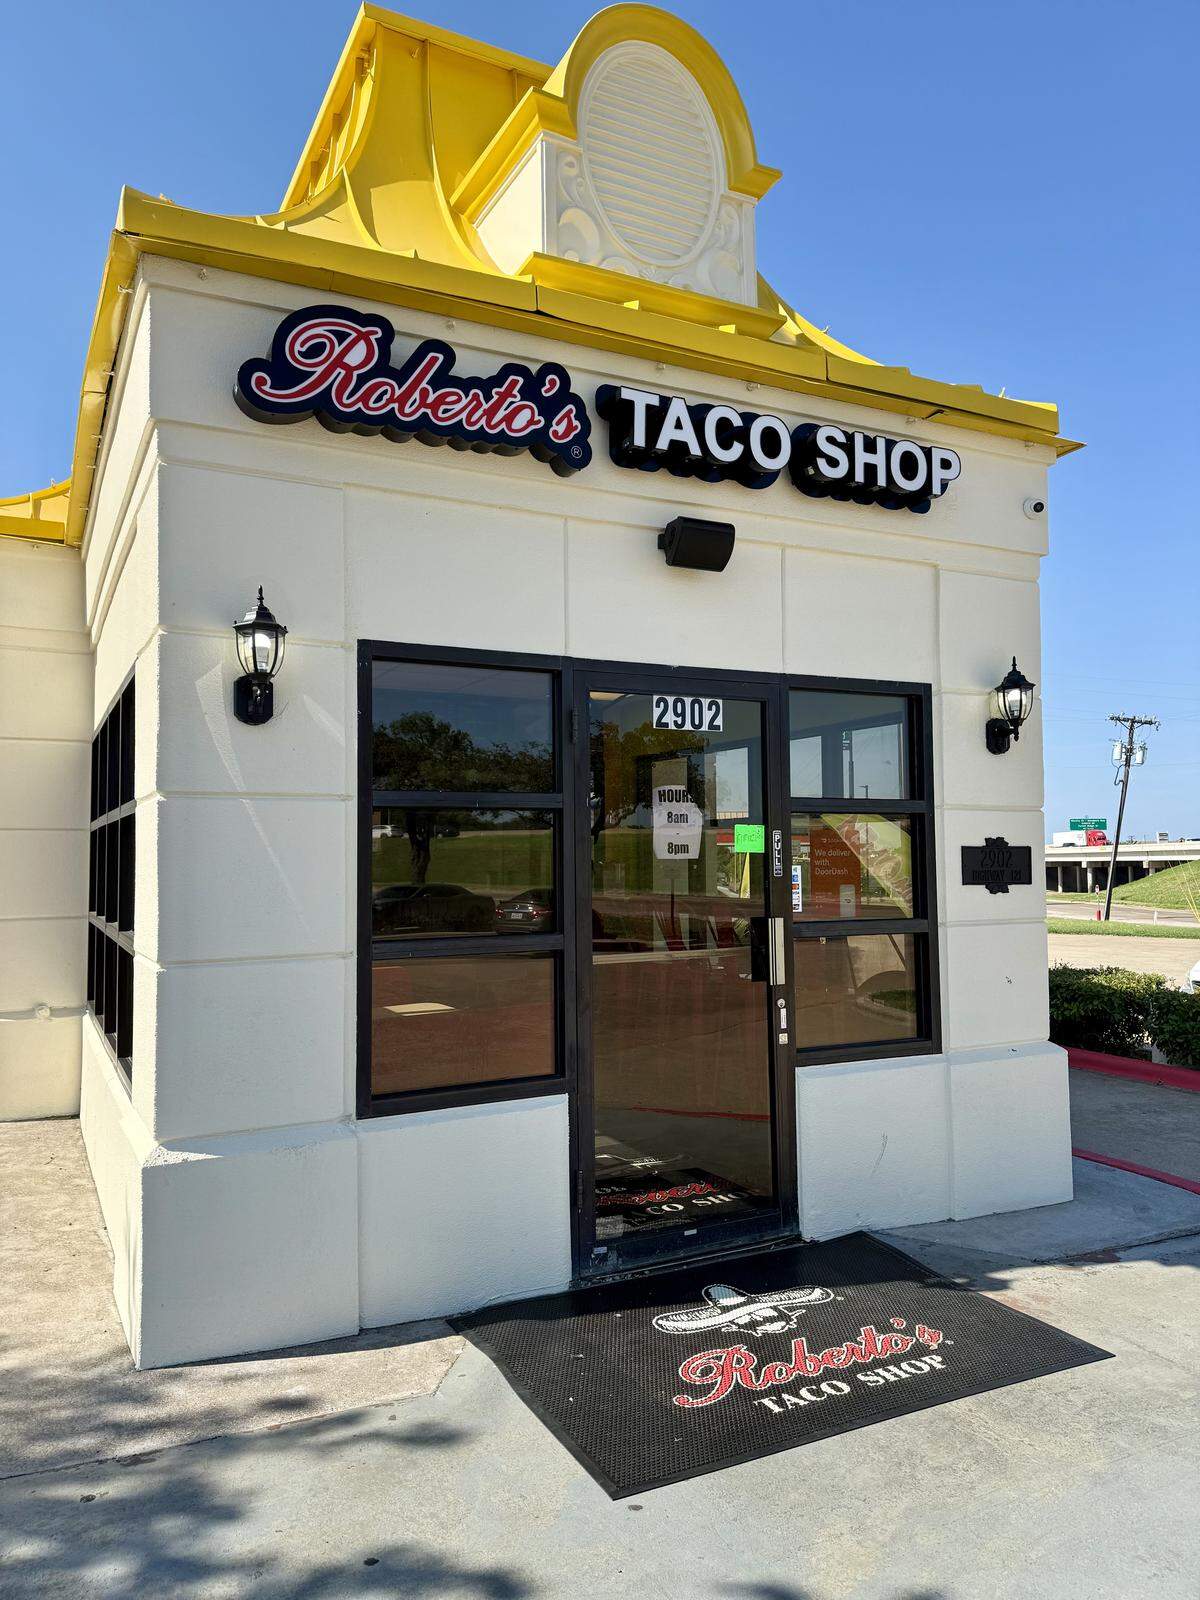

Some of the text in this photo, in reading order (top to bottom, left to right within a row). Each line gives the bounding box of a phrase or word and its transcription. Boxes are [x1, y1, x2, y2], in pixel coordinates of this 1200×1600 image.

[251, 318, 581, 443] Roberto's
[620, 386, 961, 495] TACO SHOP
[655, 696, 721, 731] 2902
[666, 811, 689, 824] 8am
[667, 842, 690, 855] 8pm
[814, 849, 850, 857] We deliver
[981, 849, 1013, 868] 2902
[814, 866, 849, 875] DoorDash
[673, 1317, 942, 1407] Roberto's
[754, 1354, 947, 1414] TACO SHOP
